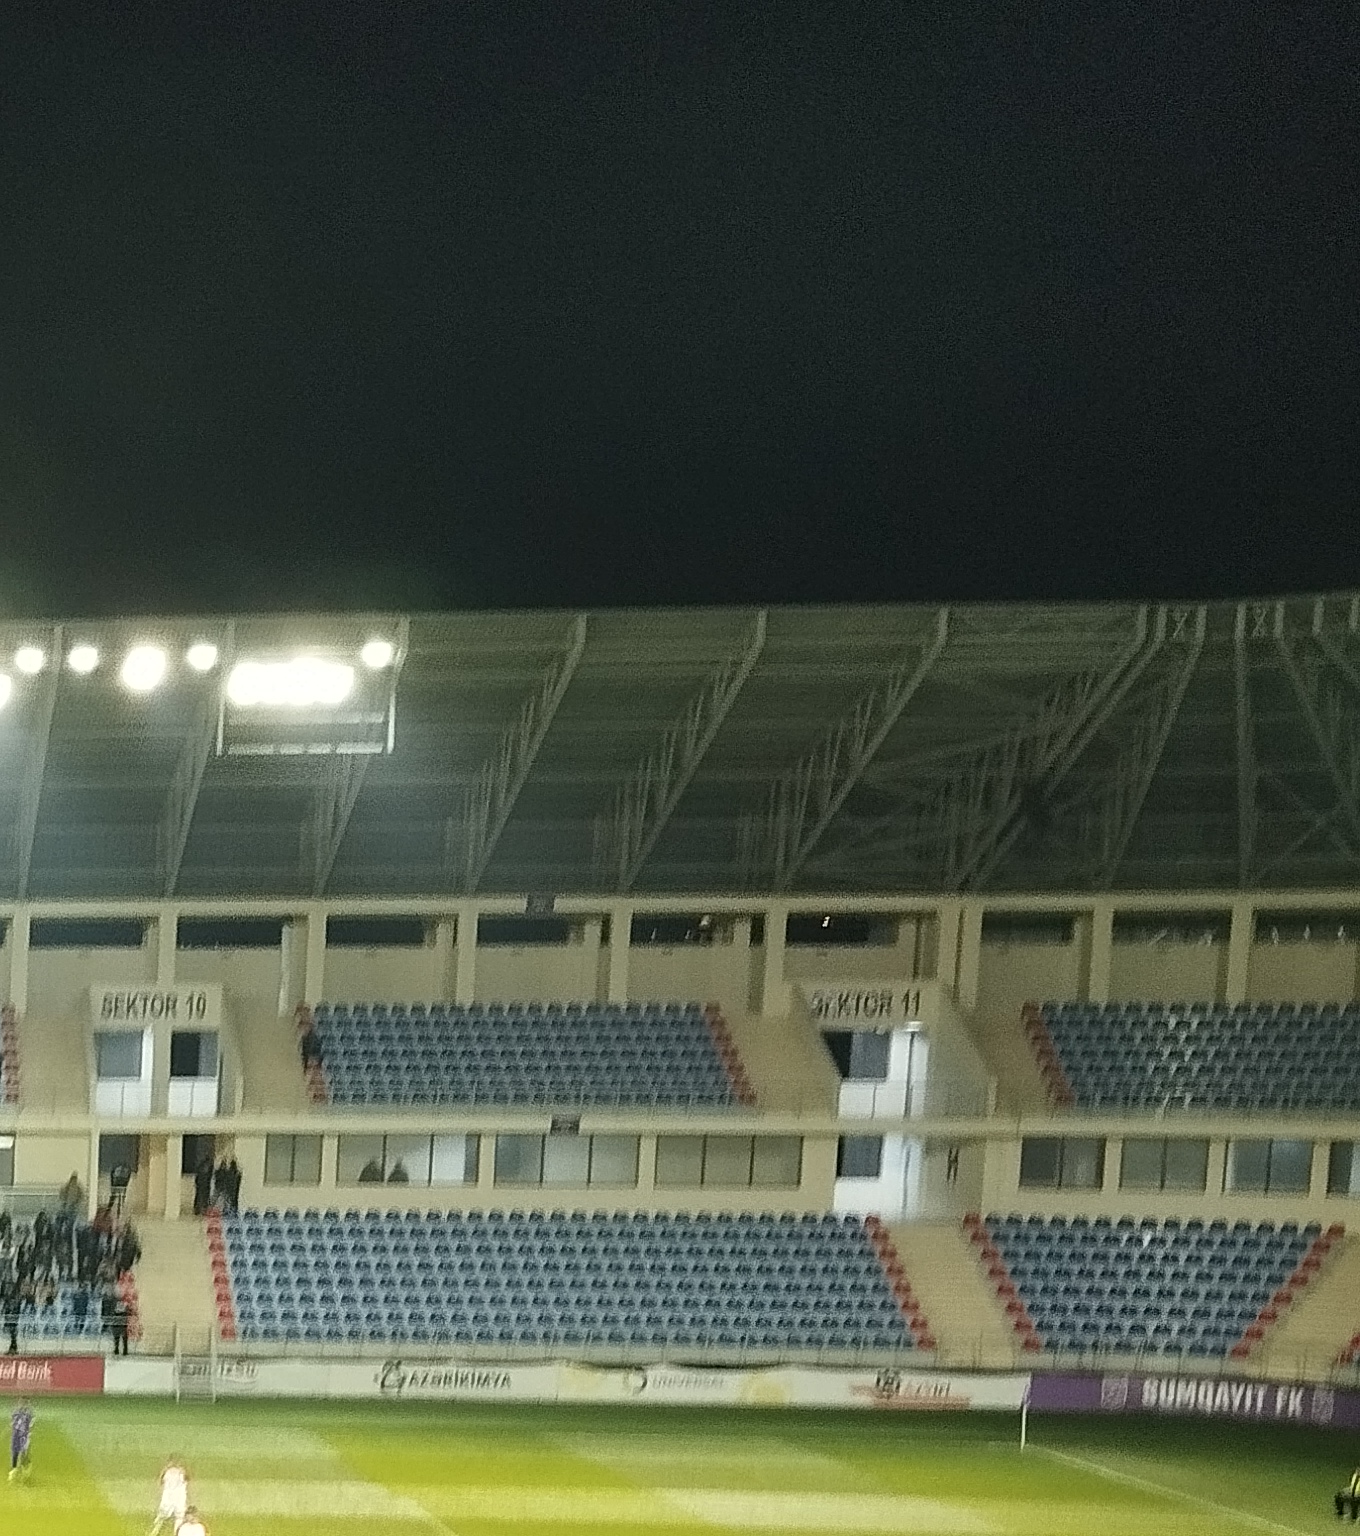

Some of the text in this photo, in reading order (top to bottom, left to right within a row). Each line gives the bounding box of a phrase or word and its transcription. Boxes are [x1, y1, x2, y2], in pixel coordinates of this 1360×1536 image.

[101, 991, 206, 1019] SEKTOR 10
[810, 988, 920, 1019] SEKTOR 11
[17, 1360, 52, 1381] Bank
[1276, 1384, 1305, 1418] FK
